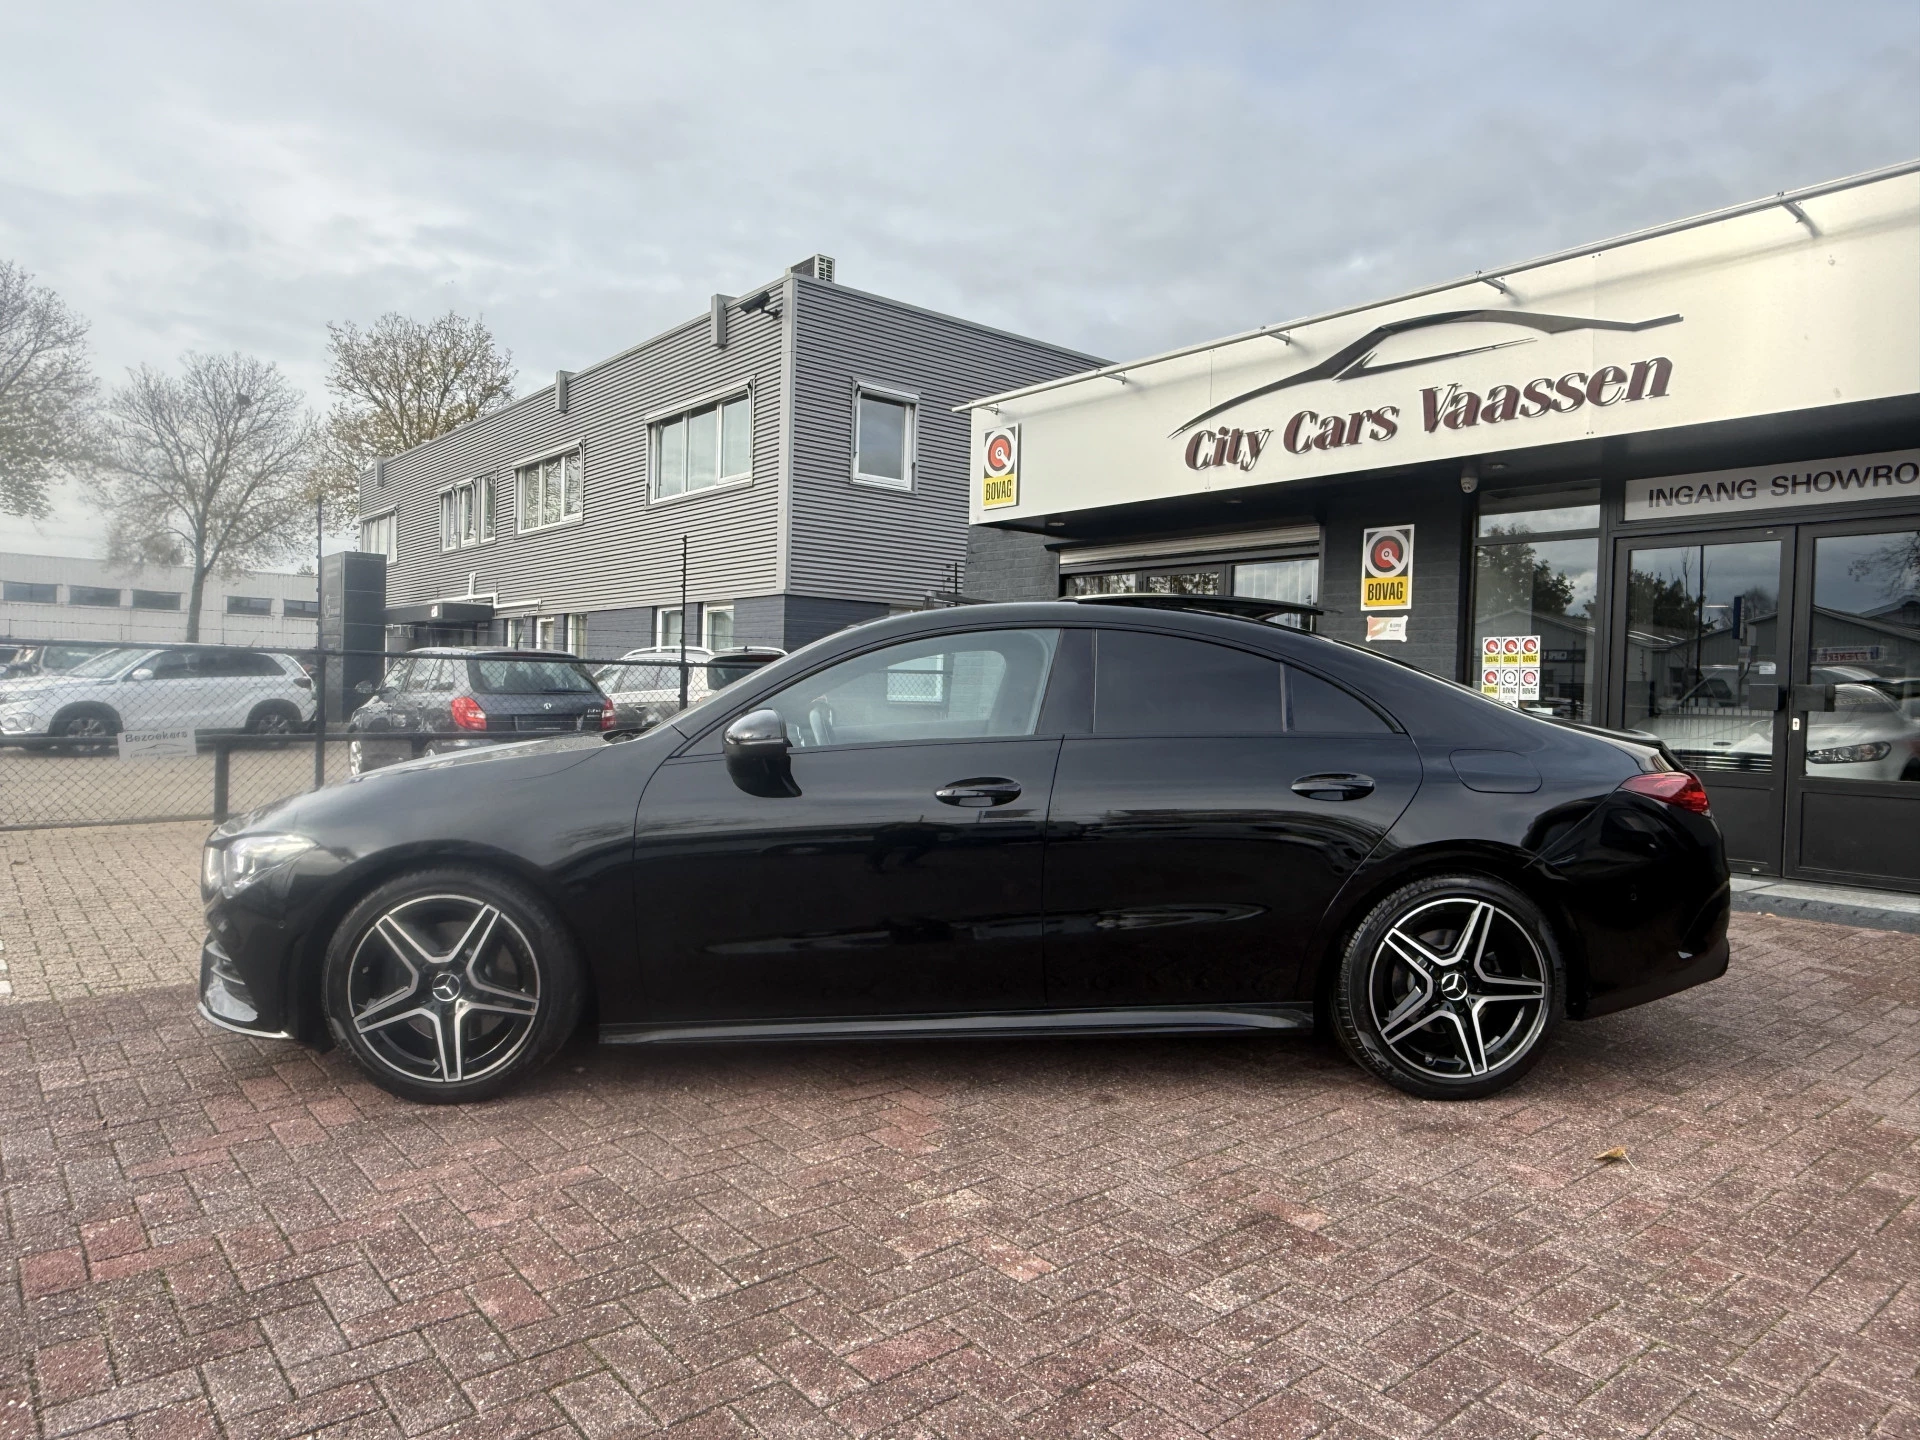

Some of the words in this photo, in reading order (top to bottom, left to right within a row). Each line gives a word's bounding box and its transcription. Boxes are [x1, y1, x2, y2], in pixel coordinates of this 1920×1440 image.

[1185, 426, 1274, 471] City
[1284, 405, 1400, 455] Cars
[1419, 356, 1673, 433] Vaassen
[985, 479, 1012, 501] BOVAG
[1648, 479, 1757, 508] INGANG
[1770, 462, 1920, 497] SHOWRO
[1367, 581, 1404, 601] BOVAG
